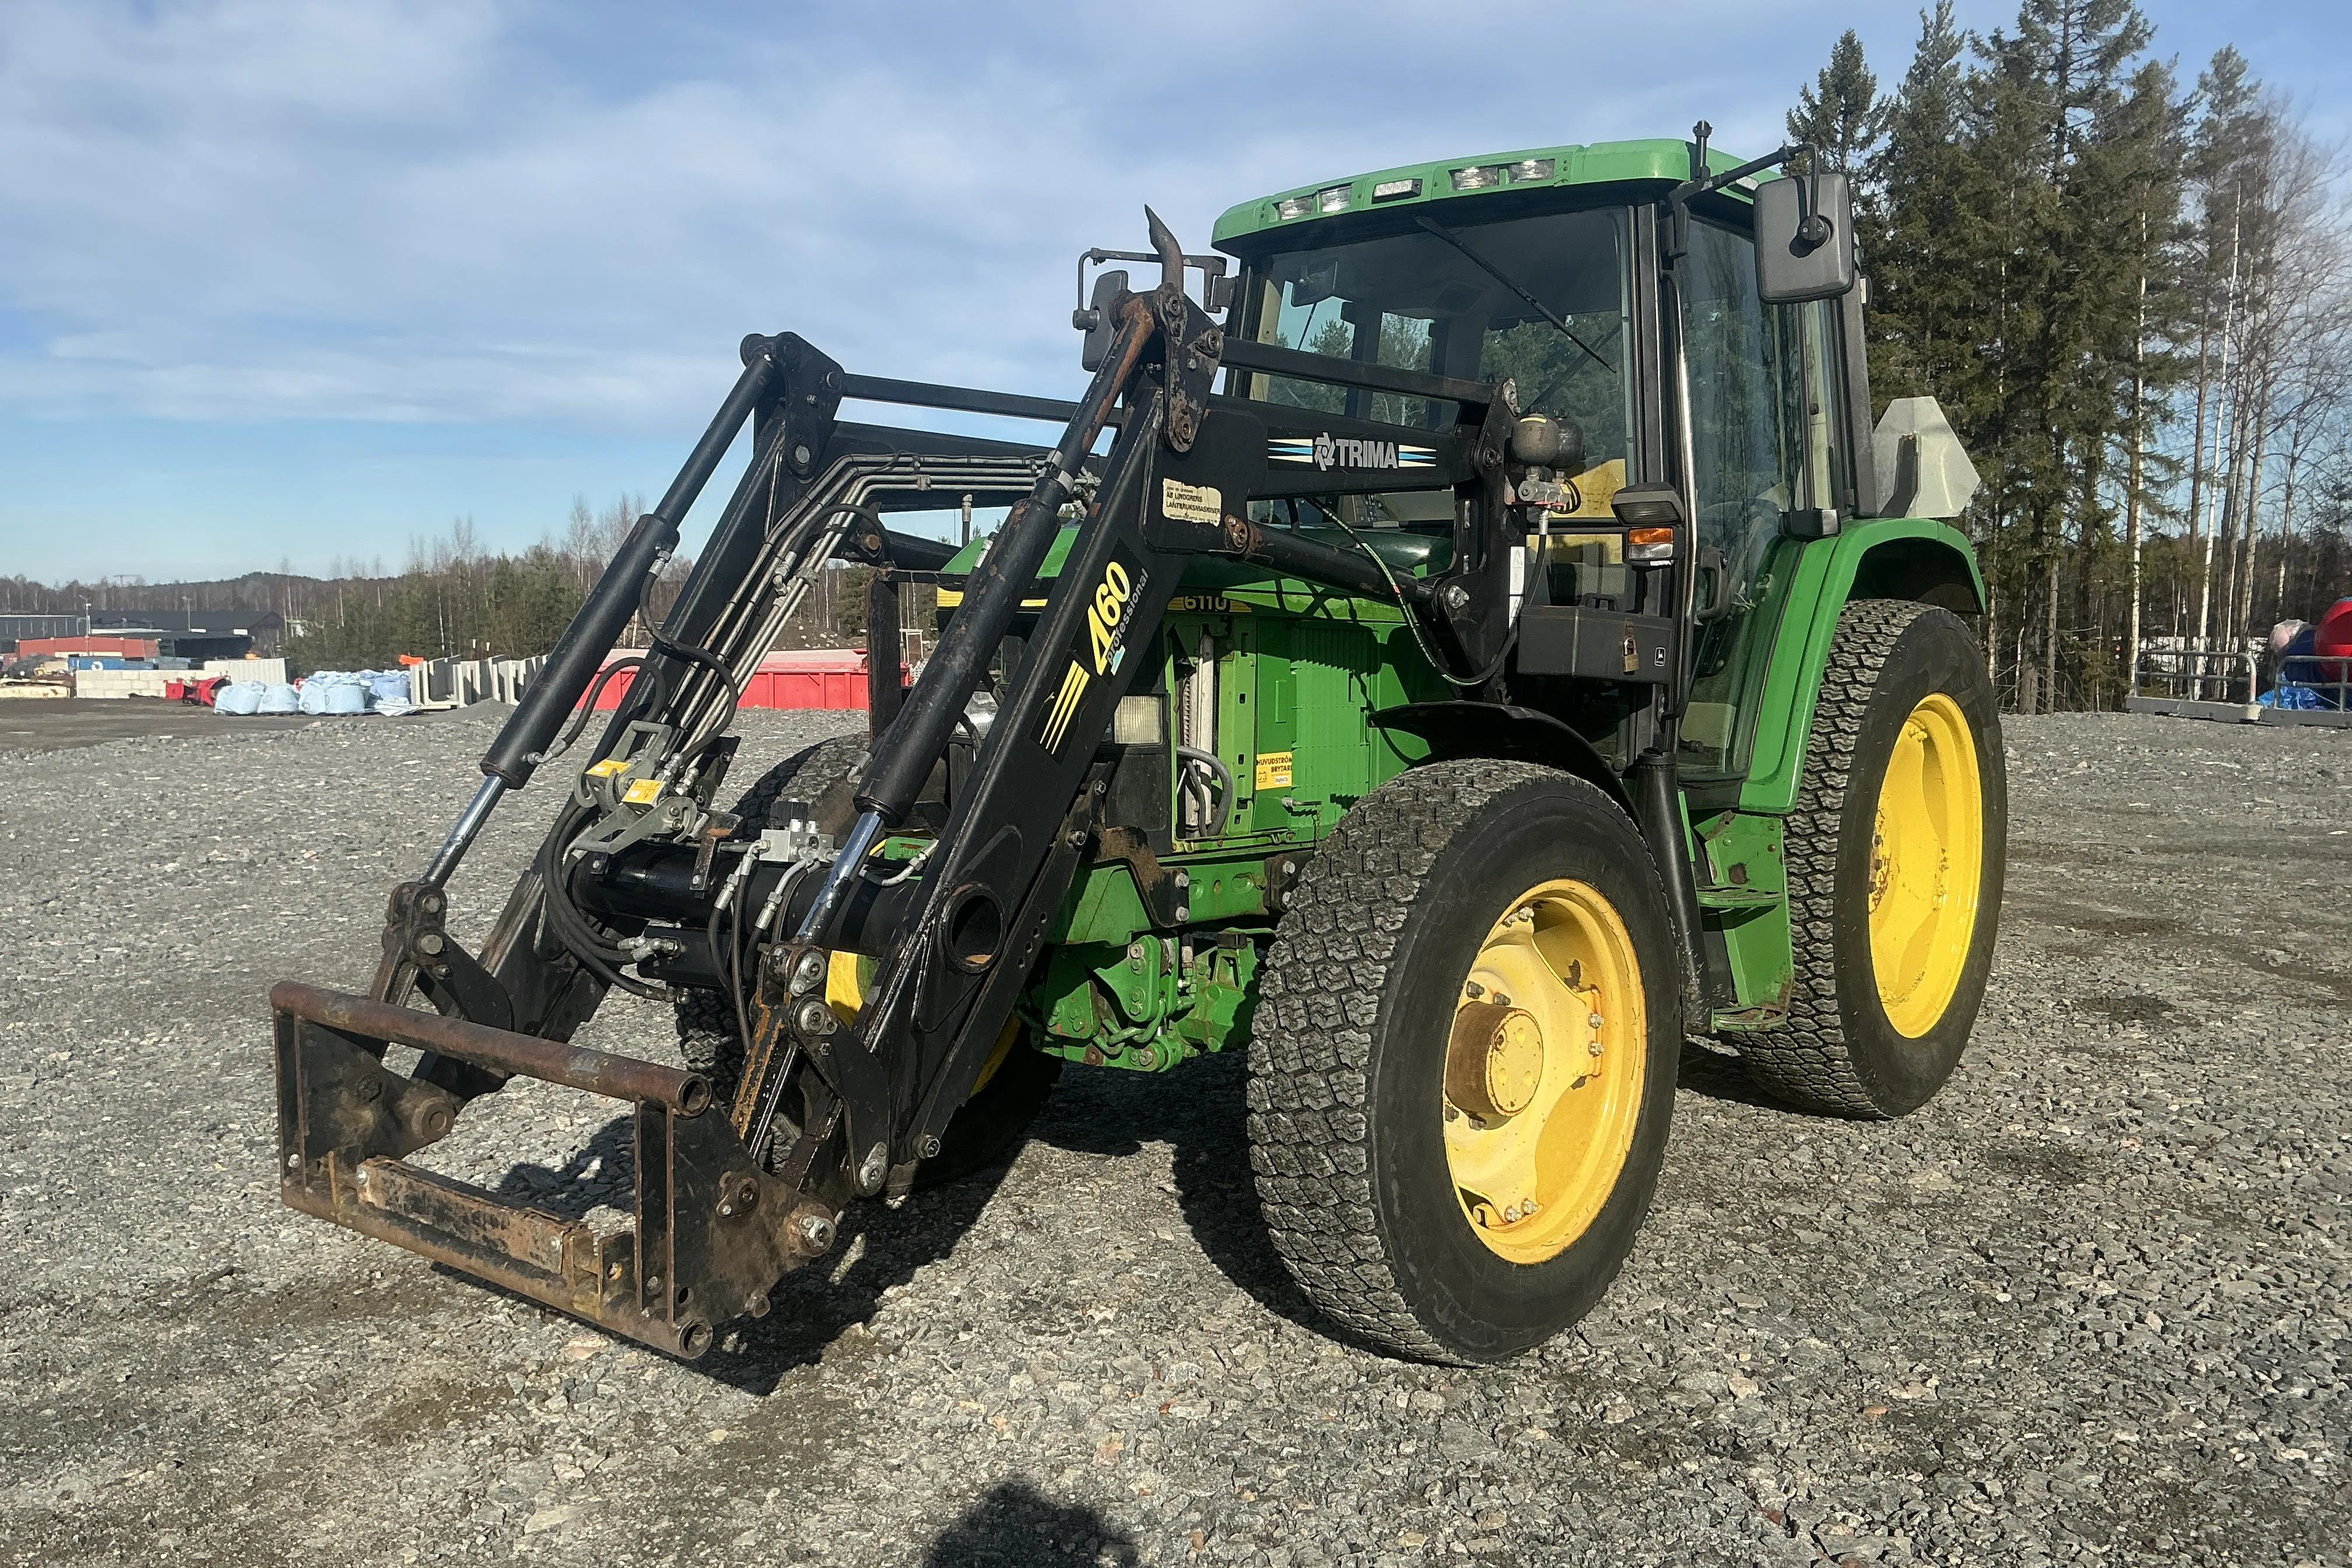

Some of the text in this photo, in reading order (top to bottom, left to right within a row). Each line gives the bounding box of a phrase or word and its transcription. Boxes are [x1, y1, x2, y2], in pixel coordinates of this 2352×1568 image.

[1336, 439, 1398, 469] TRIMA
[1088, 562, 1130, 676] 460
[1107, 568, 1149, 666] professional
[1185, 596, 1227, 610] 6110
